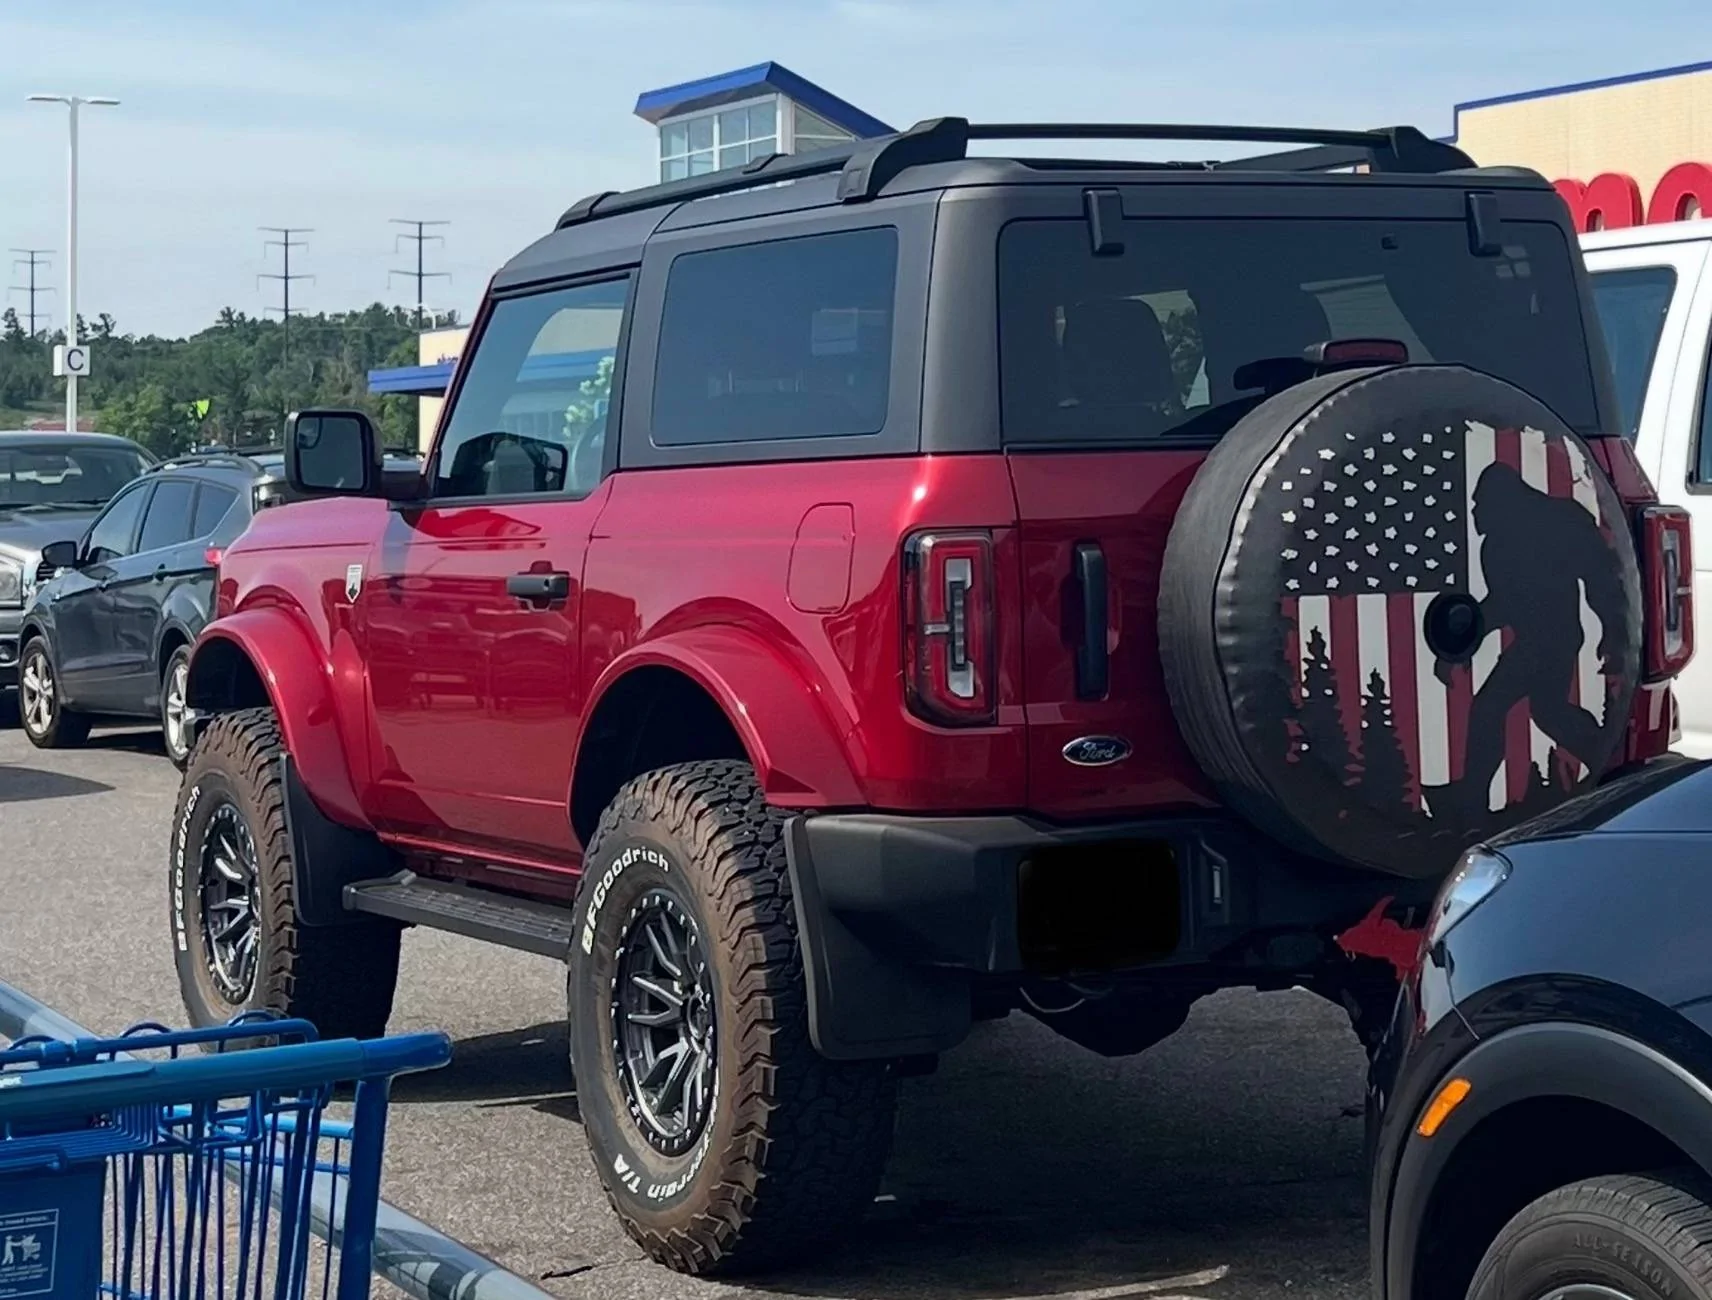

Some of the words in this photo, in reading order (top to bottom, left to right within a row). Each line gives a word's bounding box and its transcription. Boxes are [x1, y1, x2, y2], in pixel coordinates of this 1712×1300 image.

[67, 348, 84, 372] C
[581, 845, 670, 955] BFGoodrich
[613, 1152, 642, 1194] T/A
